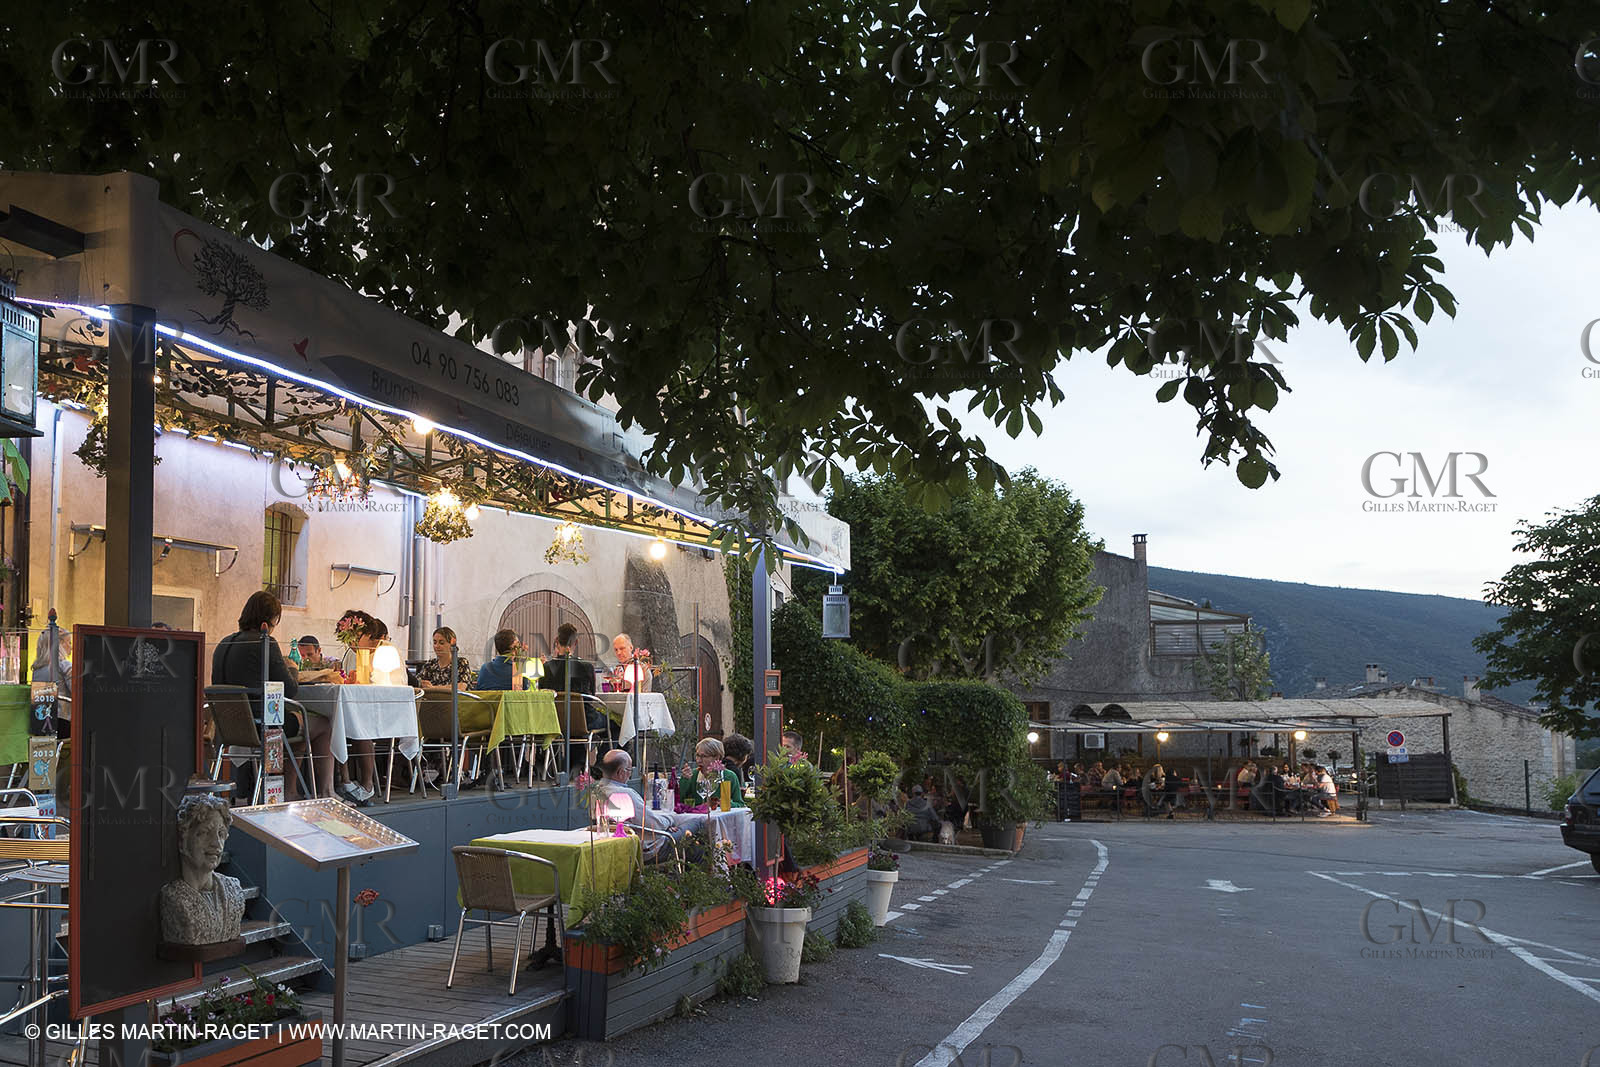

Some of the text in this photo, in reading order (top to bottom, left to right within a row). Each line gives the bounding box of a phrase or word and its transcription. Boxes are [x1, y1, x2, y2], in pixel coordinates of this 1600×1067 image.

[411, 341, 520, 407] 04 90 756 083
[371, 370, 420, 401] Brunch
[34, 694, 55, 703] 2018
[33, 749, 54, 758] 2013
[39, 808, 55, 817] 014
